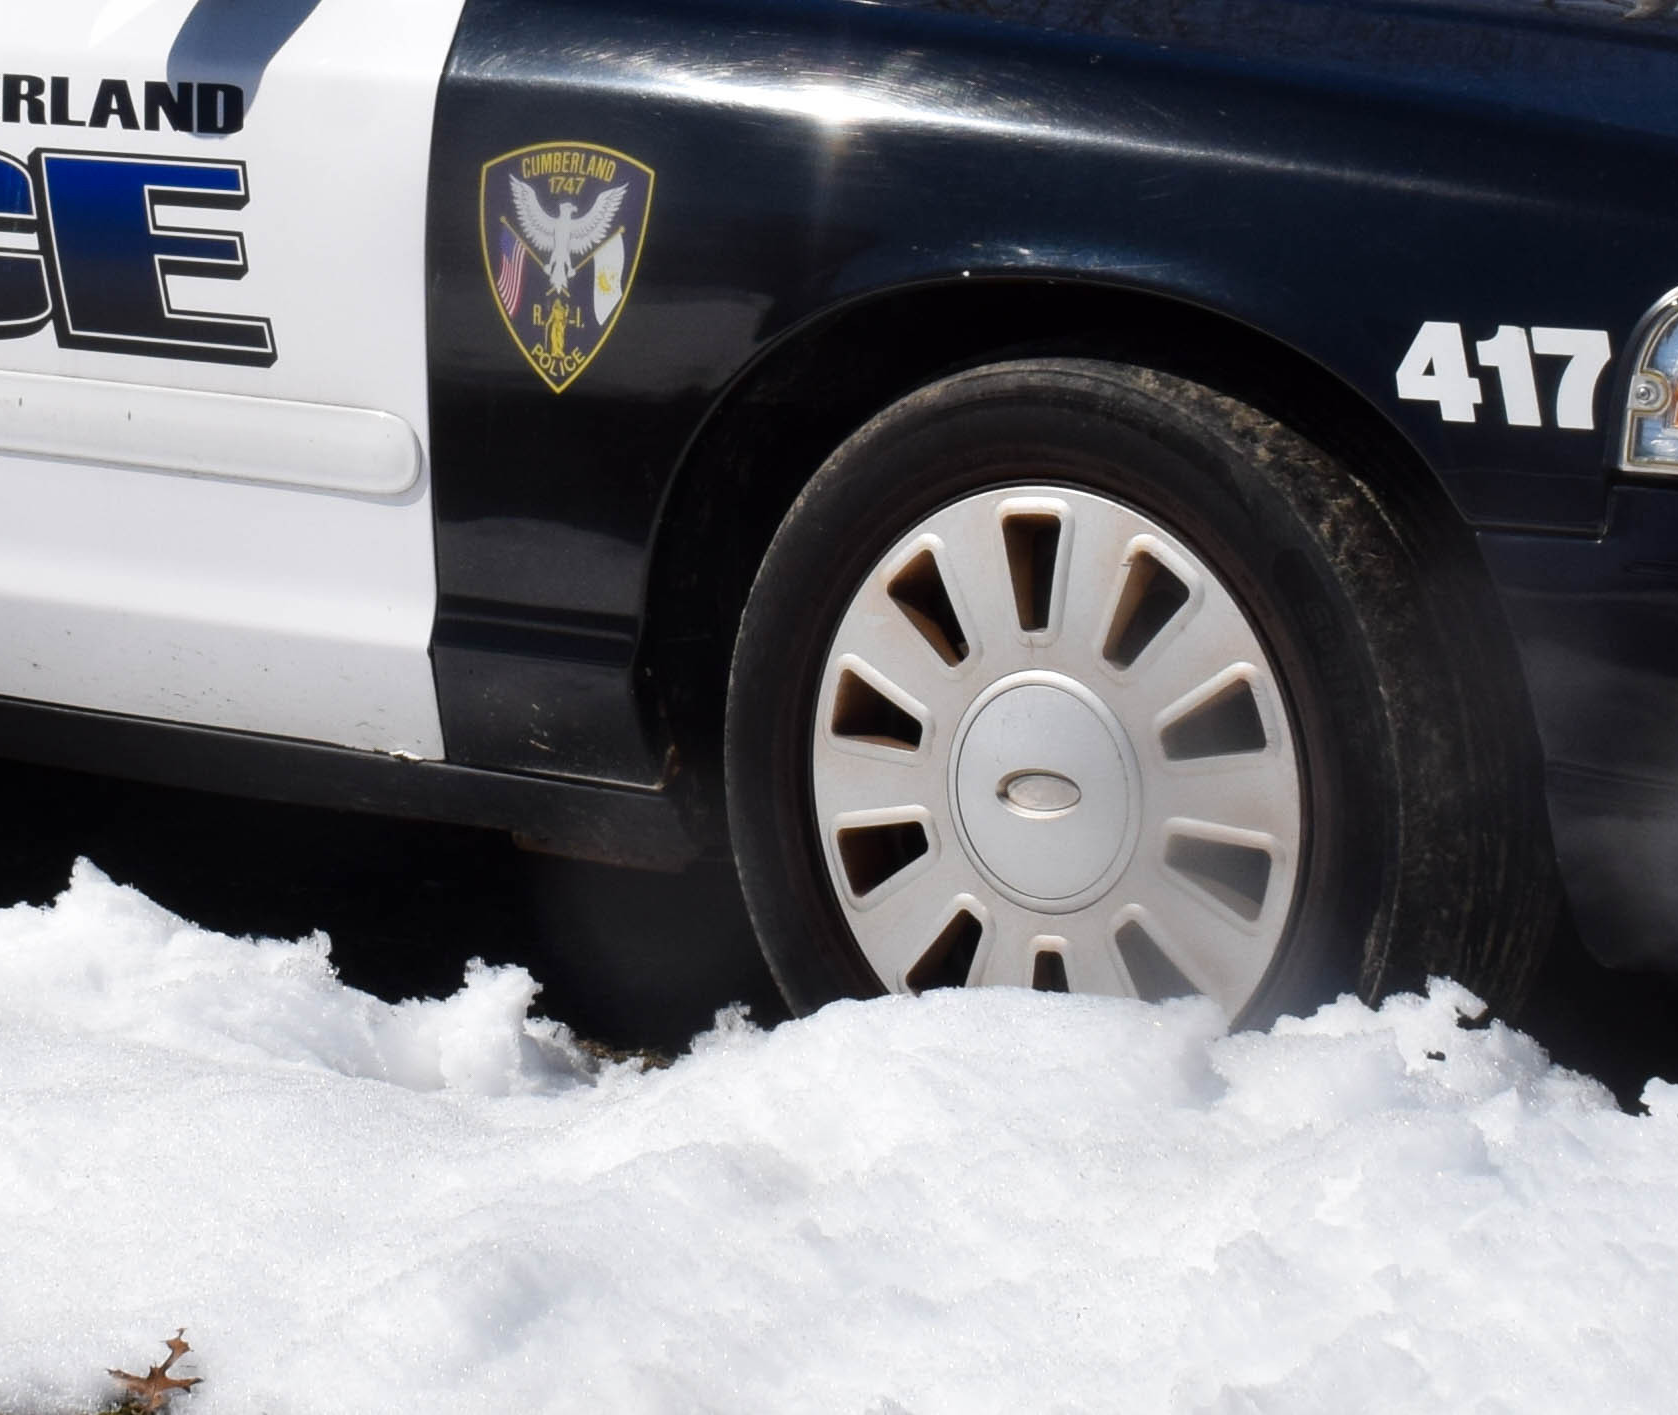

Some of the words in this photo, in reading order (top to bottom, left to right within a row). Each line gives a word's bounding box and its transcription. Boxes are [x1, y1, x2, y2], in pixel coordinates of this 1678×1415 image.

[521, 151, 616, 183] CUMBERLAND
[548, 176, 586, 194] 1747
[531, 343, 585, 377] POLICE
[1395, 321, 1611, 430] 417
